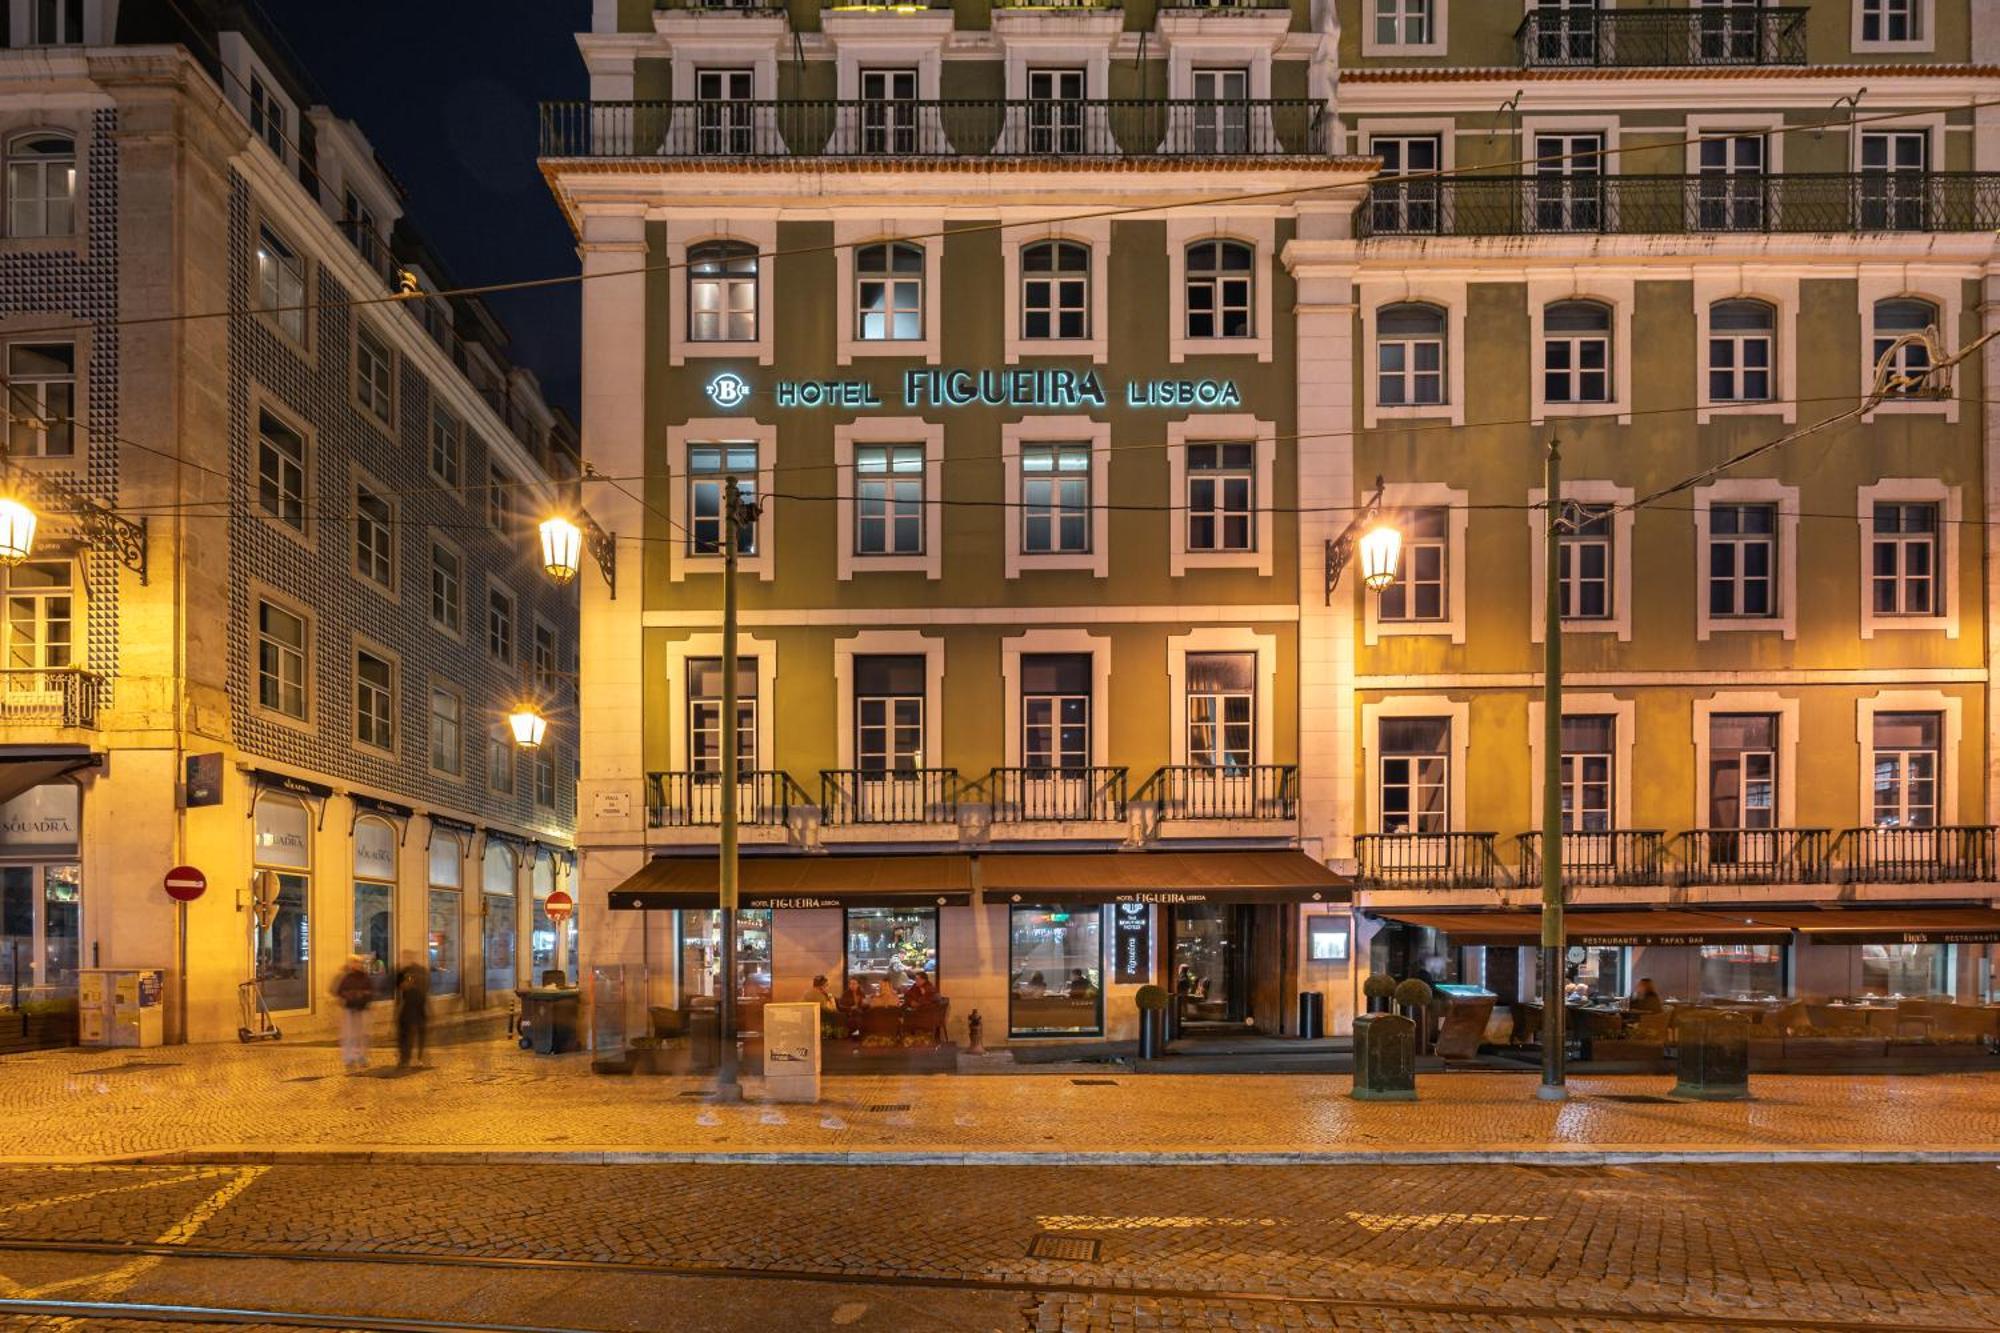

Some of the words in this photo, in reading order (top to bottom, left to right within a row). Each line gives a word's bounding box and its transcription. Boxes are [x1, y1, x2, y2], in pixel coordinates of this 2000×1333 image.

[776, 381, 881, 406] HOTEL
[903, 369, 1106, 406] FIGUEIRA
[1128, 380, 1241, 406] LISBOA
[770, 898, 820, 908] FIGUEIRA
[1136, 893, 1186, 903] FIGUEIRA
[1583, 937, 1637, 945] RESTAURANTE
[1127, 938, 1137, 975] Figueira
